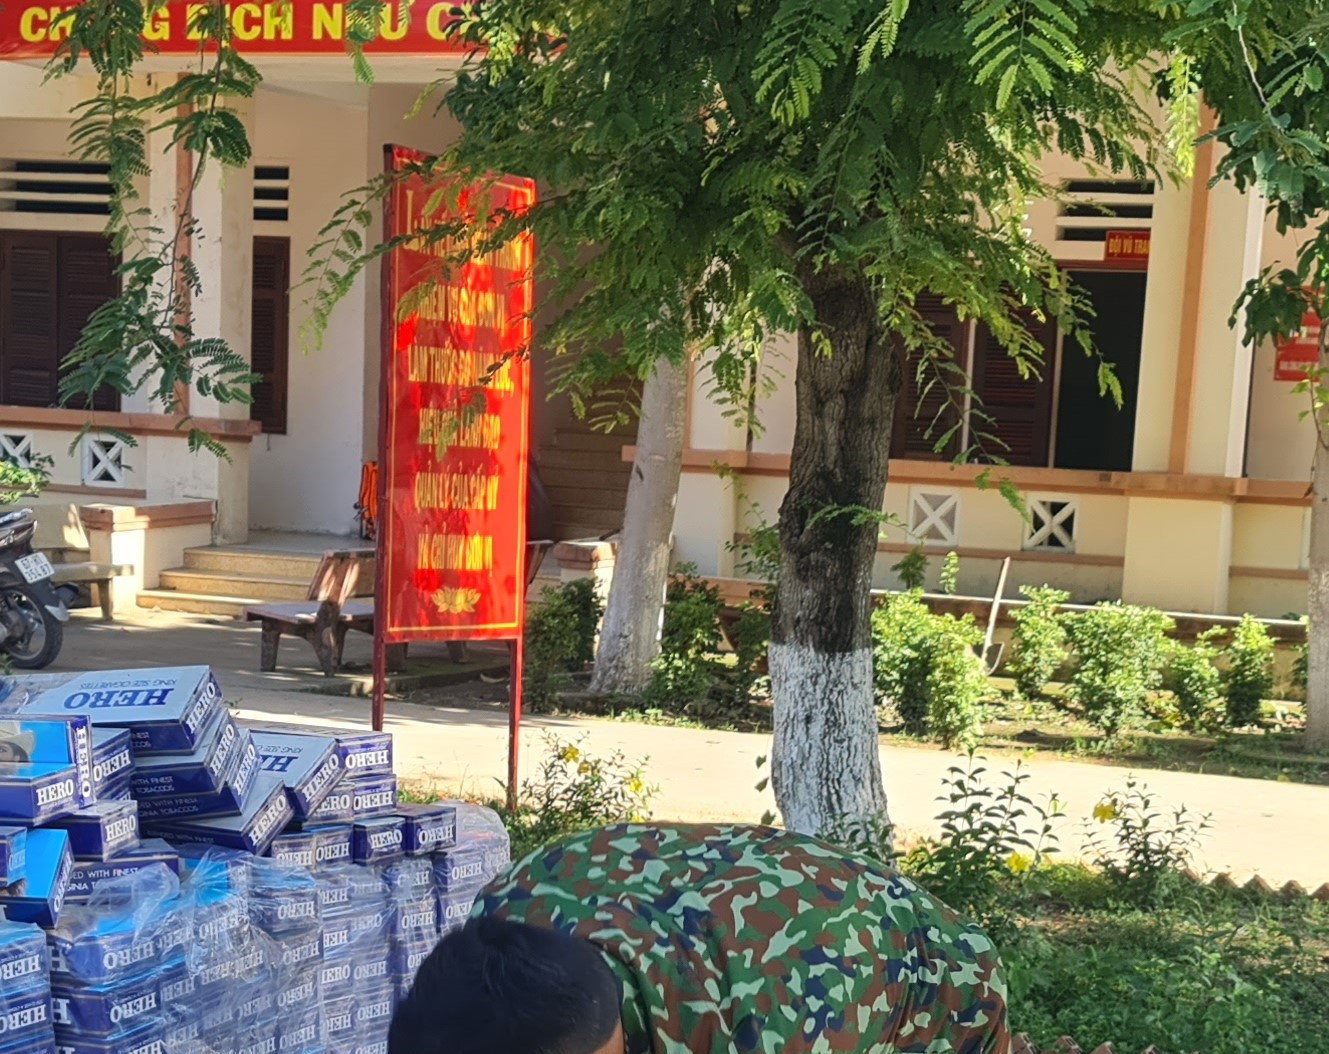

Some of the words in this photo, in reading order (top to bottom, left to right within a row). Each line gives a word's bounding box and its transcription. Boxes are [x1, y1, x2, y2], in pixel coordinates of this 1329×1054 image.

[64, 688, 174, 709] HERO
[185, 683, 216, 733] HERO
[76, 727, 92, 799] HERO
[210, 724, 234, 776] HERO
[346, 750, 389, 769] HERO
[93, 750, 131, 782] HERO
[233, 744, 256, 795] HERO
[302, 754, 340, 802] HERO
[36, 778, 74, 806] HERO
[354, 791, 393, 811] HERO
[105, 815, 136, 842] HERO
[249, 795, 286, 846] HERO
[419, 824, 454, 844] HERO
[316, 842, 350, 861] HERO
[371, 829, 403, 849] HERO
[87, 869, 111, 878] WITH
[110, 992, 156, 1023] HERO
